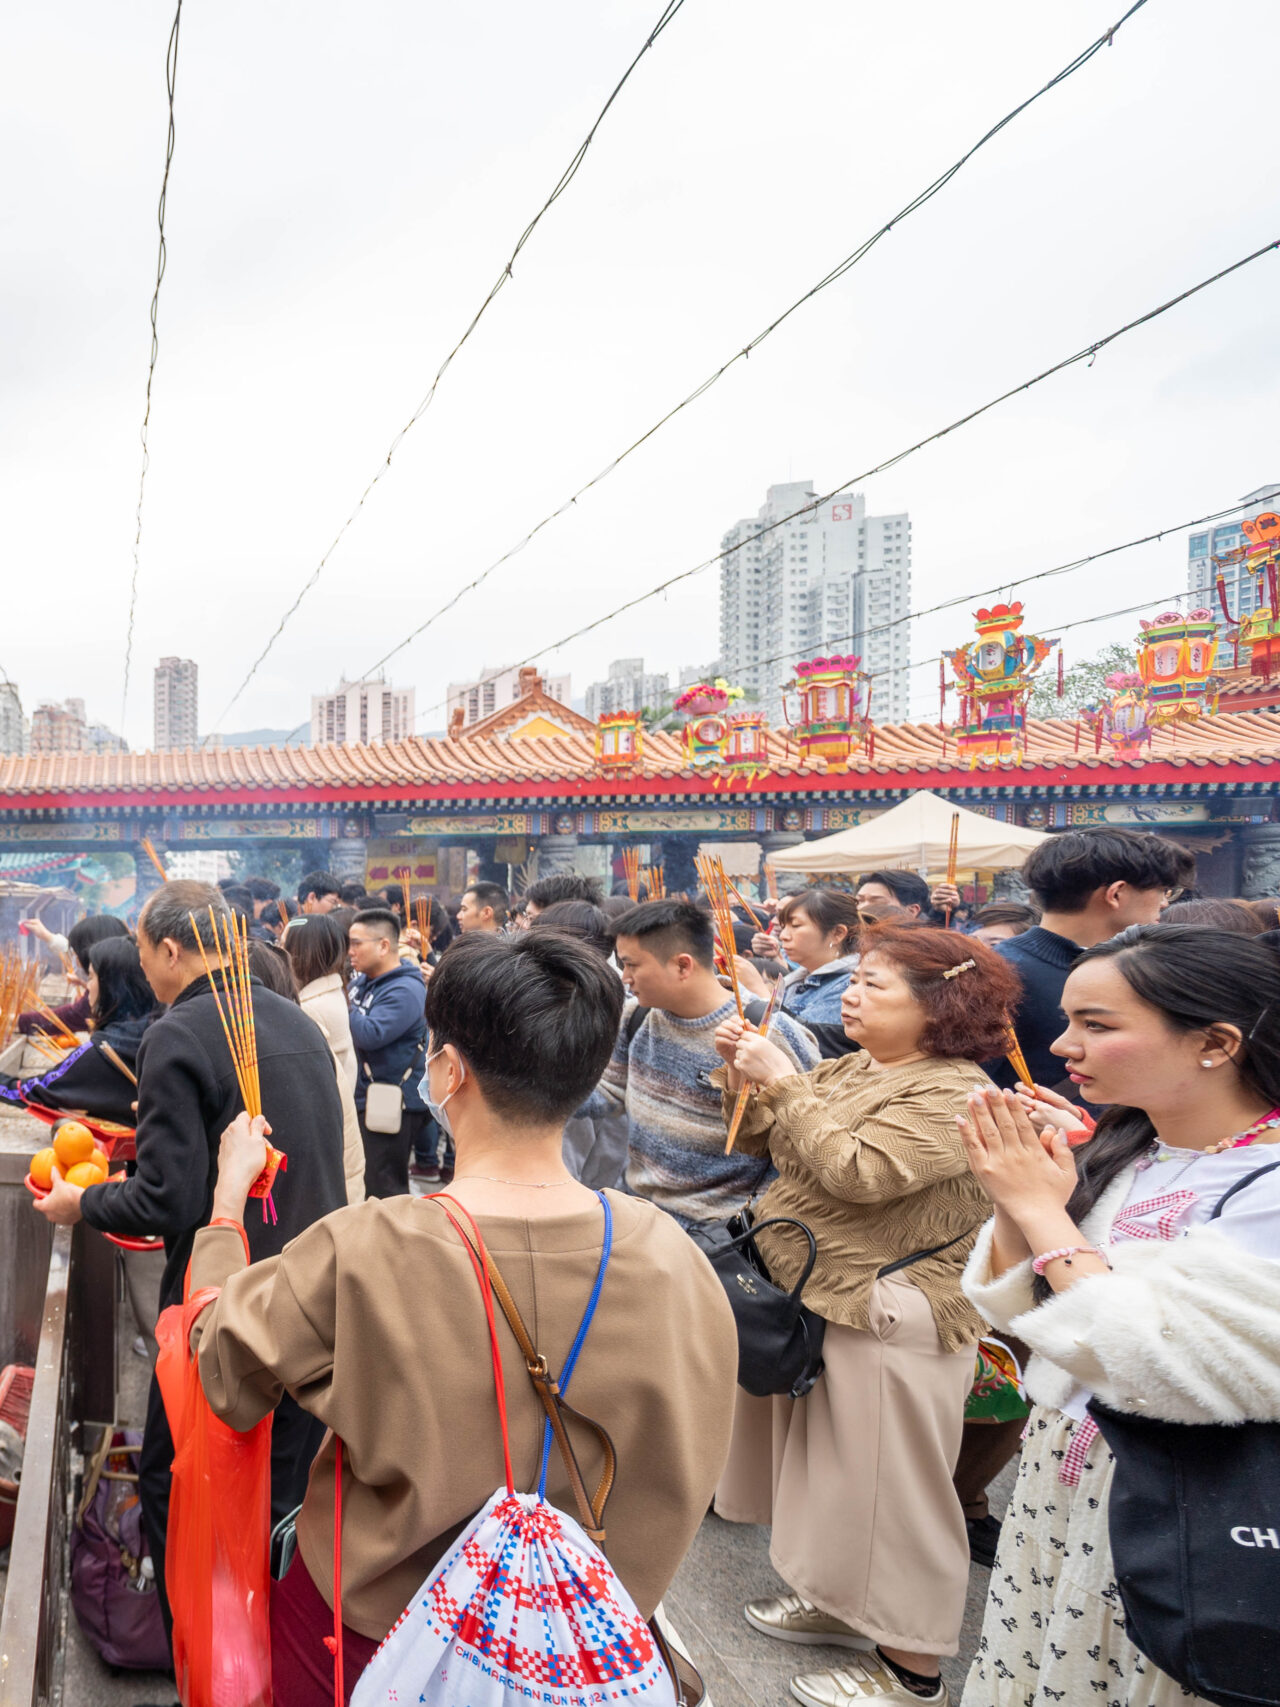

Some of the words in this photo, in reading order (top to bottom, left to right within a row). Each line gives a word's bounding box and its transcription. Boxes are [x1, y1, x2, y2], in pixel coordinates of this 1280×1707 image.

[390, 842, 417, 854] Exit
[455, 1645, 480, 1668] CHIBI
[481, 1663, 541, 1701] MARCHAN
[543, 1692, 568, 1706] RUN
[570, 1695, 587, 1707] HK
